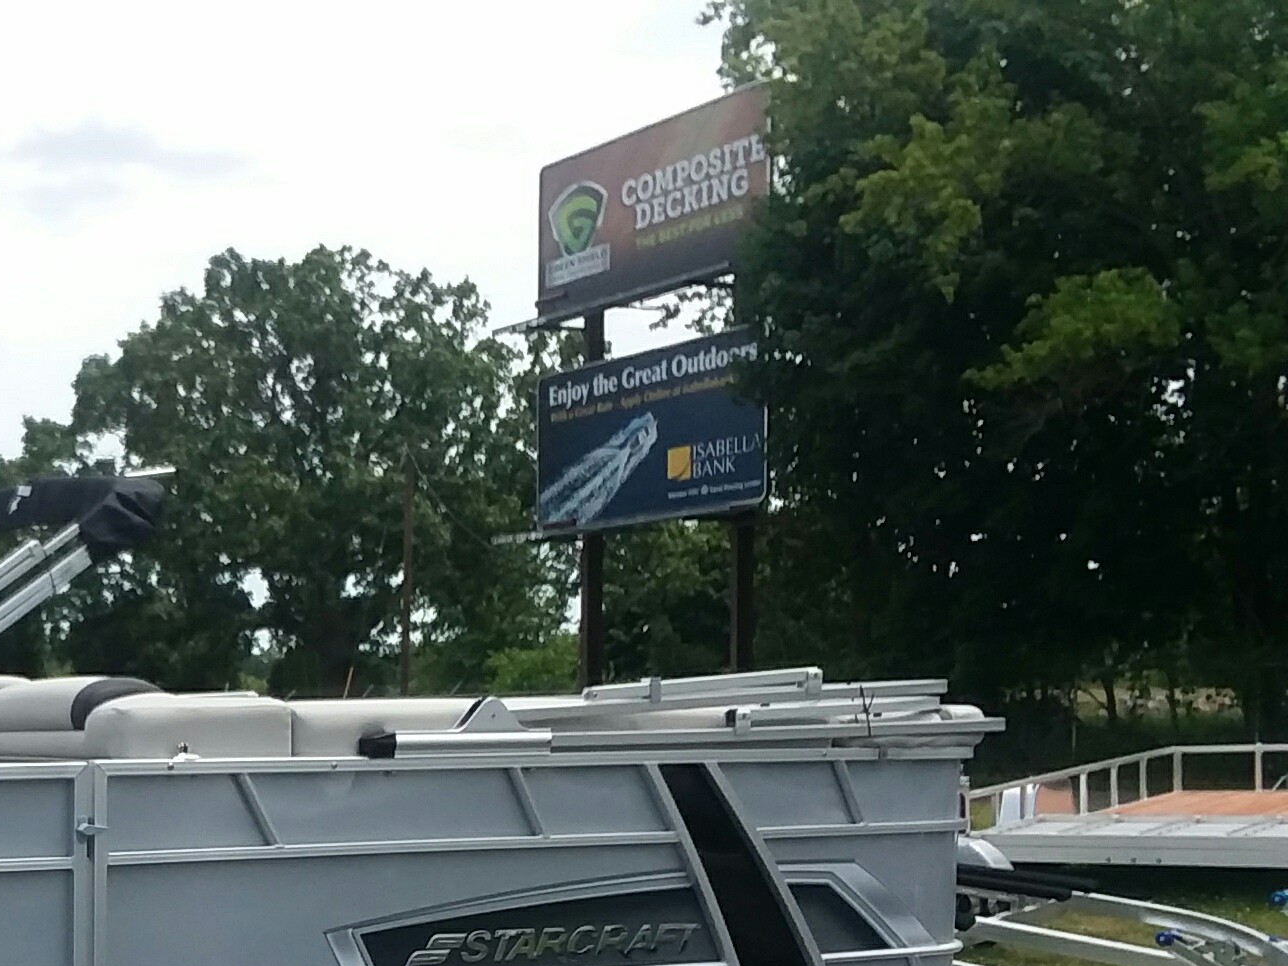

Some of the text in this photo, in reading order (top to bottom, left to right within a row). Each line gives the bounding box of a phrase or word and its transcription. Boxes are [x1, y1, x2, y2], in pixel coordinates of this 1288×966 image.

[622, 133, 765, 206] COMPOSITE
[635, 168, 748, 230] DECKING
[549, 380, 590, 410] Enjoy
[593, 372, 618, 397] the
[621, 359, 668, 389] Great
[693, 432, 762, 461] ISABELLA
[693, 456, 736, 479] BANK
[461, 922, 702, 963] STARCRAFT
